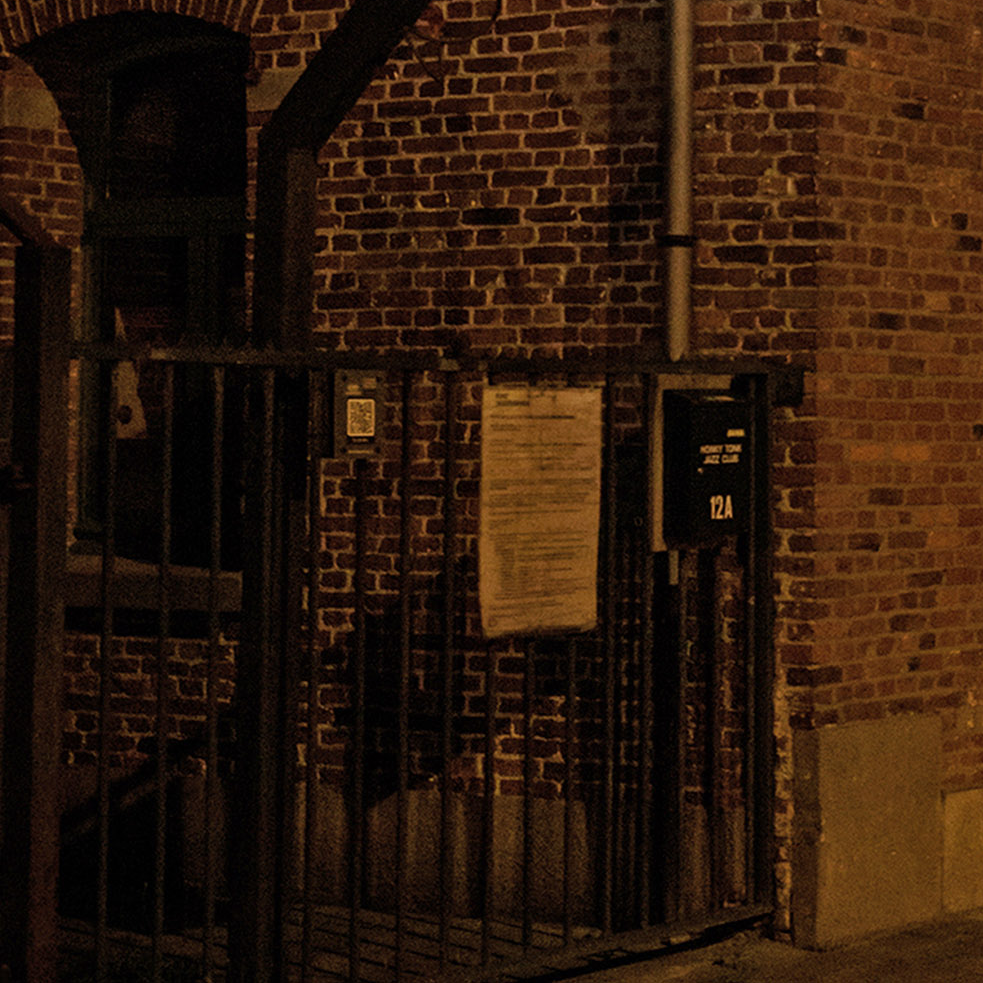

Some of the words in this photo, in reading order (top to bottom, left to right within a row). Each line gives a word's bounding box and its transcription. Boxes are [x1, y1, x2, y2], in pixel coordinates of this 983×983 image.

[703, 454, 720, 465] JAZZ
[721, 454, 740, 464] CLUB
[709, 494, 733, 520] 12A
